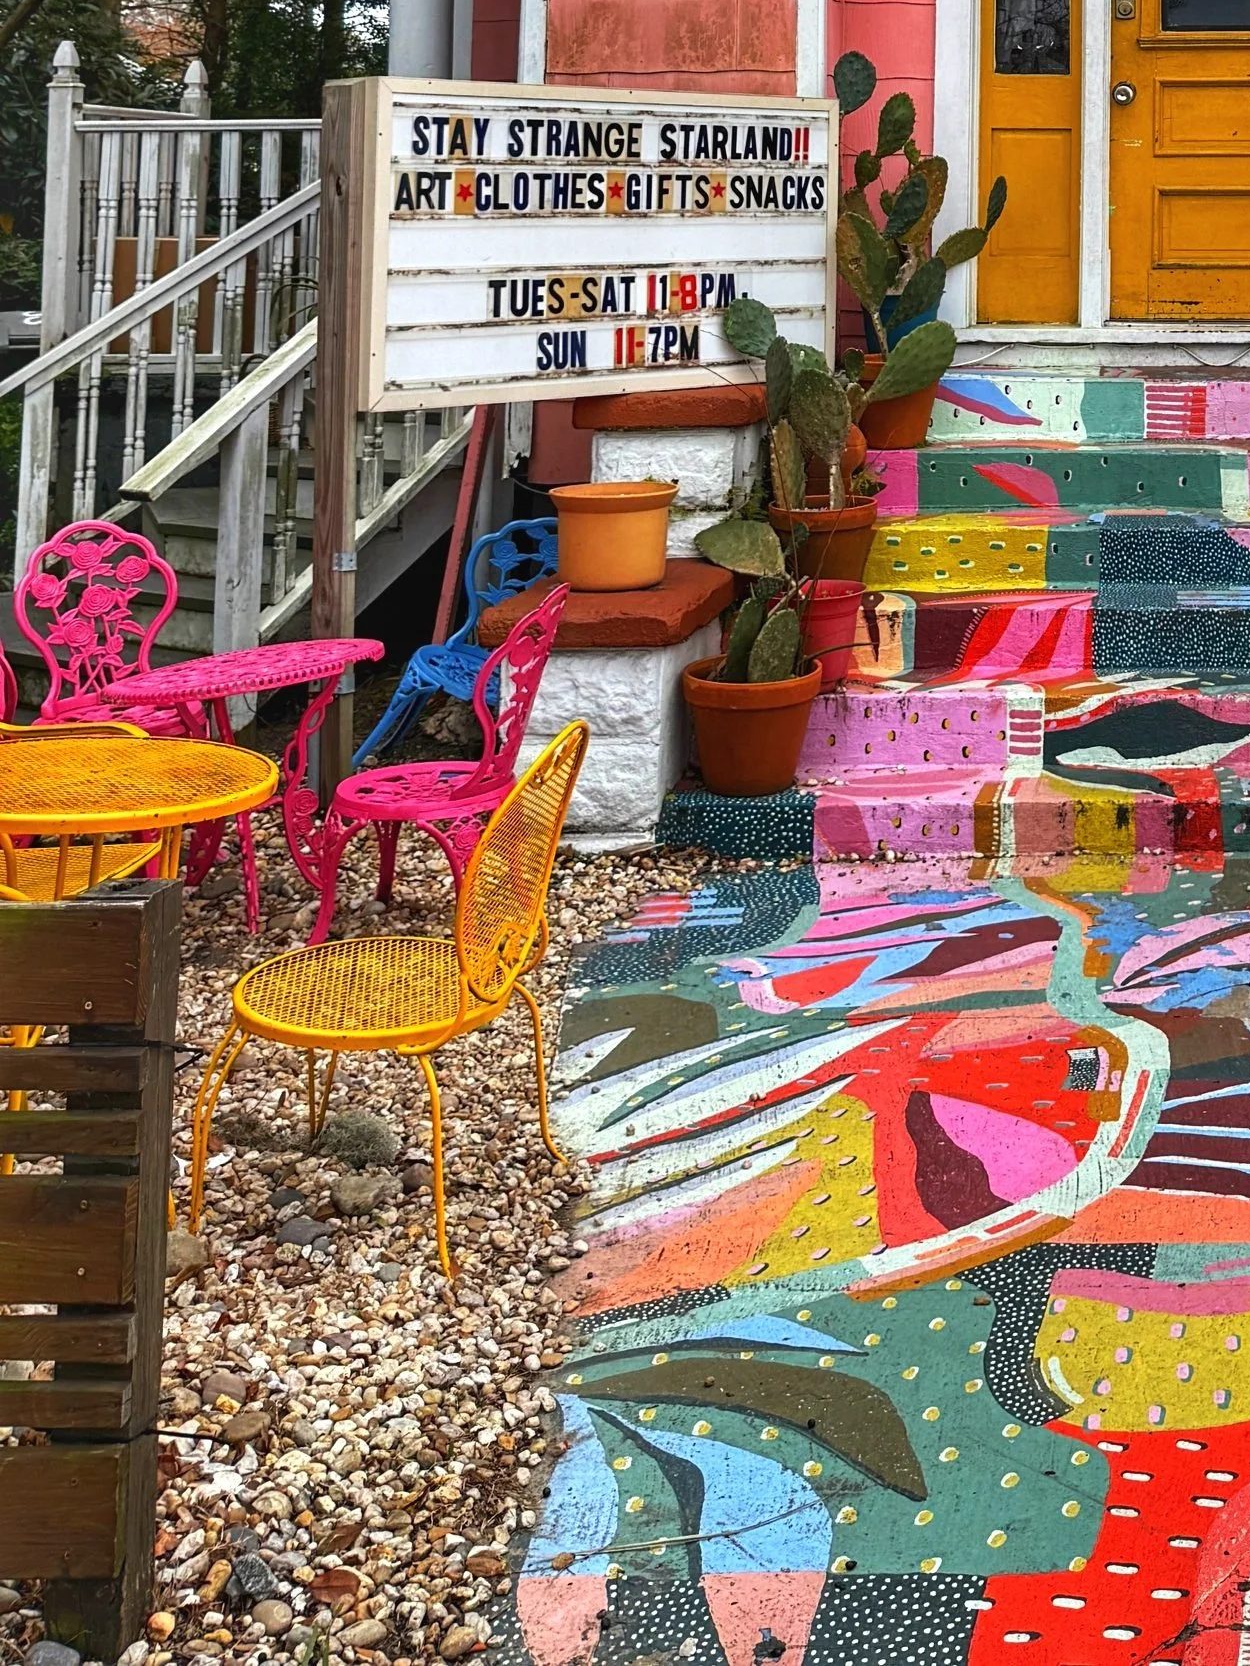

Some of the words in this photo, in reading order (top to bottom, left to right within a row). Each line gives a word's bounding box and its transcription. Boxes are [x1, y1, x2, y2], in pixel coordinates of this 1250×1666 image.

[412, 115, 490, 156] STAY
[508, 119, 643, 158] STRANGE
[659, 123, 811, 161] STARLAND!!
[394, 172, 452, 210] ART
[475, 172, 604, 210] CLOTHES
[626, 173, 710, 210] GIFTS
[730, 175, 825, 210] SNACKS
[489, 276, 636, 317] TUES-SAT
[537, 331, 587, 370] SUN
[615, 325, 700, 366] 11-7PM
